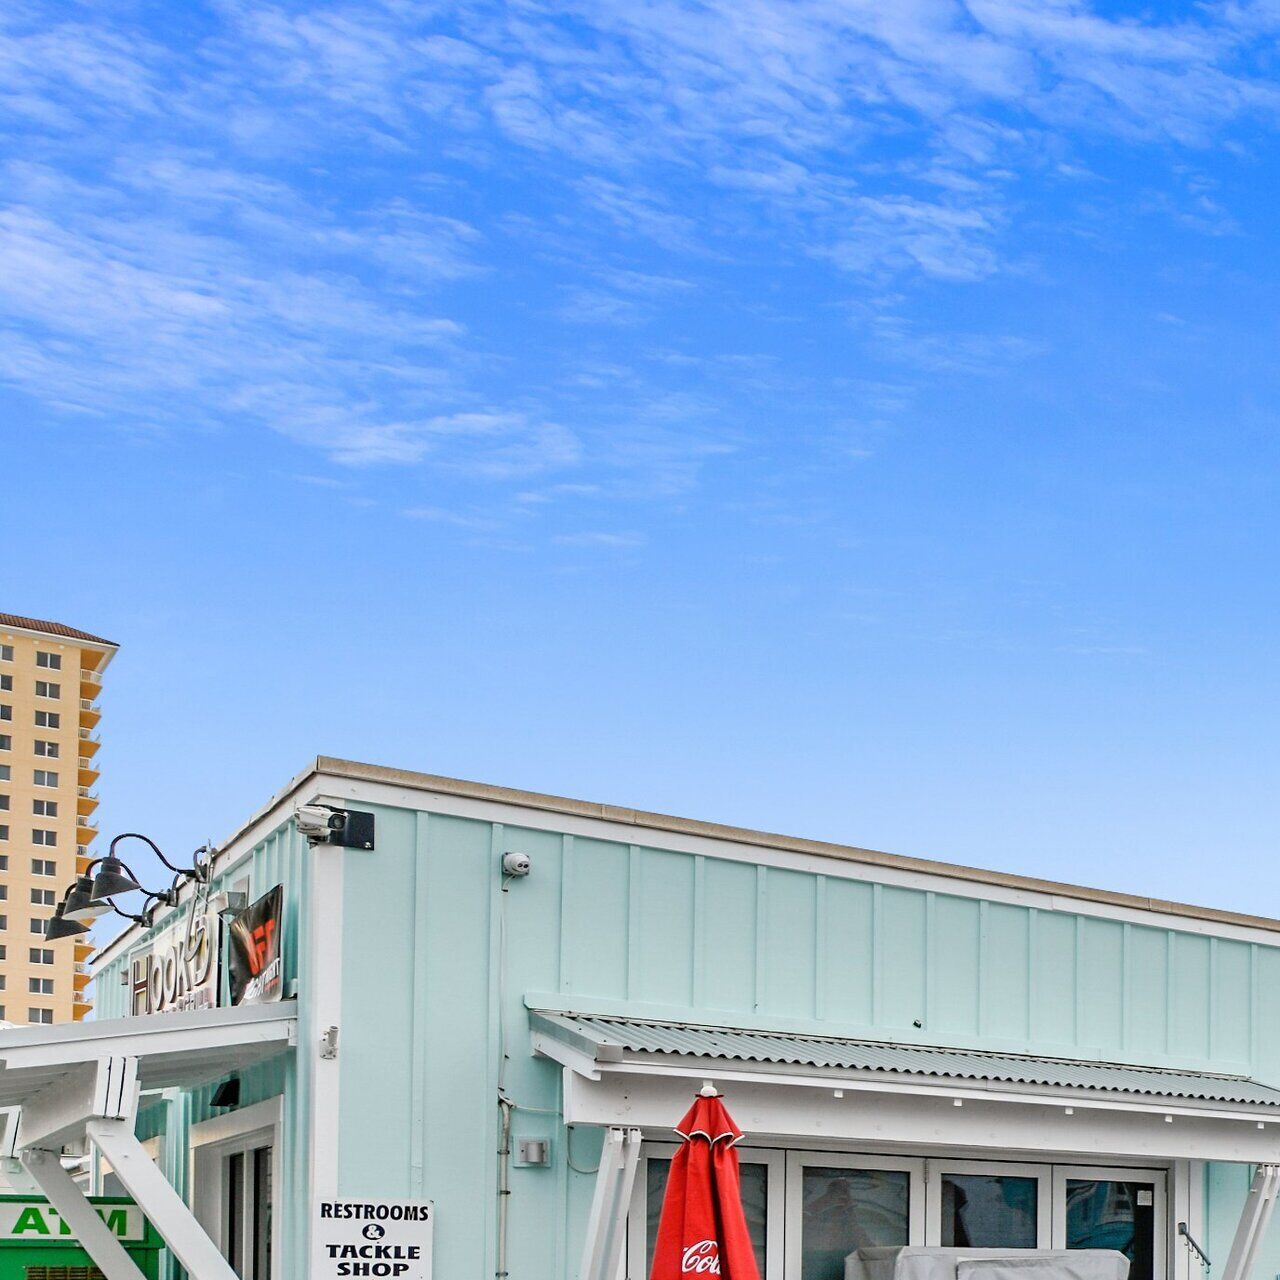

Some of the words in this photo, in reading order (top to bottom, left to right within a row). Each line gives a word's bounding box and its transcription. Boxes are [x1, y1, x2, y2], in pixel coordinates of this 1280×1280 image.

[321, 1203, 429, 1221] RESTROOMS
[368, 1223, 384, 1240] &
[326, 1244, 421, 1260] TACKLE
[337, 1262, 409, 1277] SHOP
